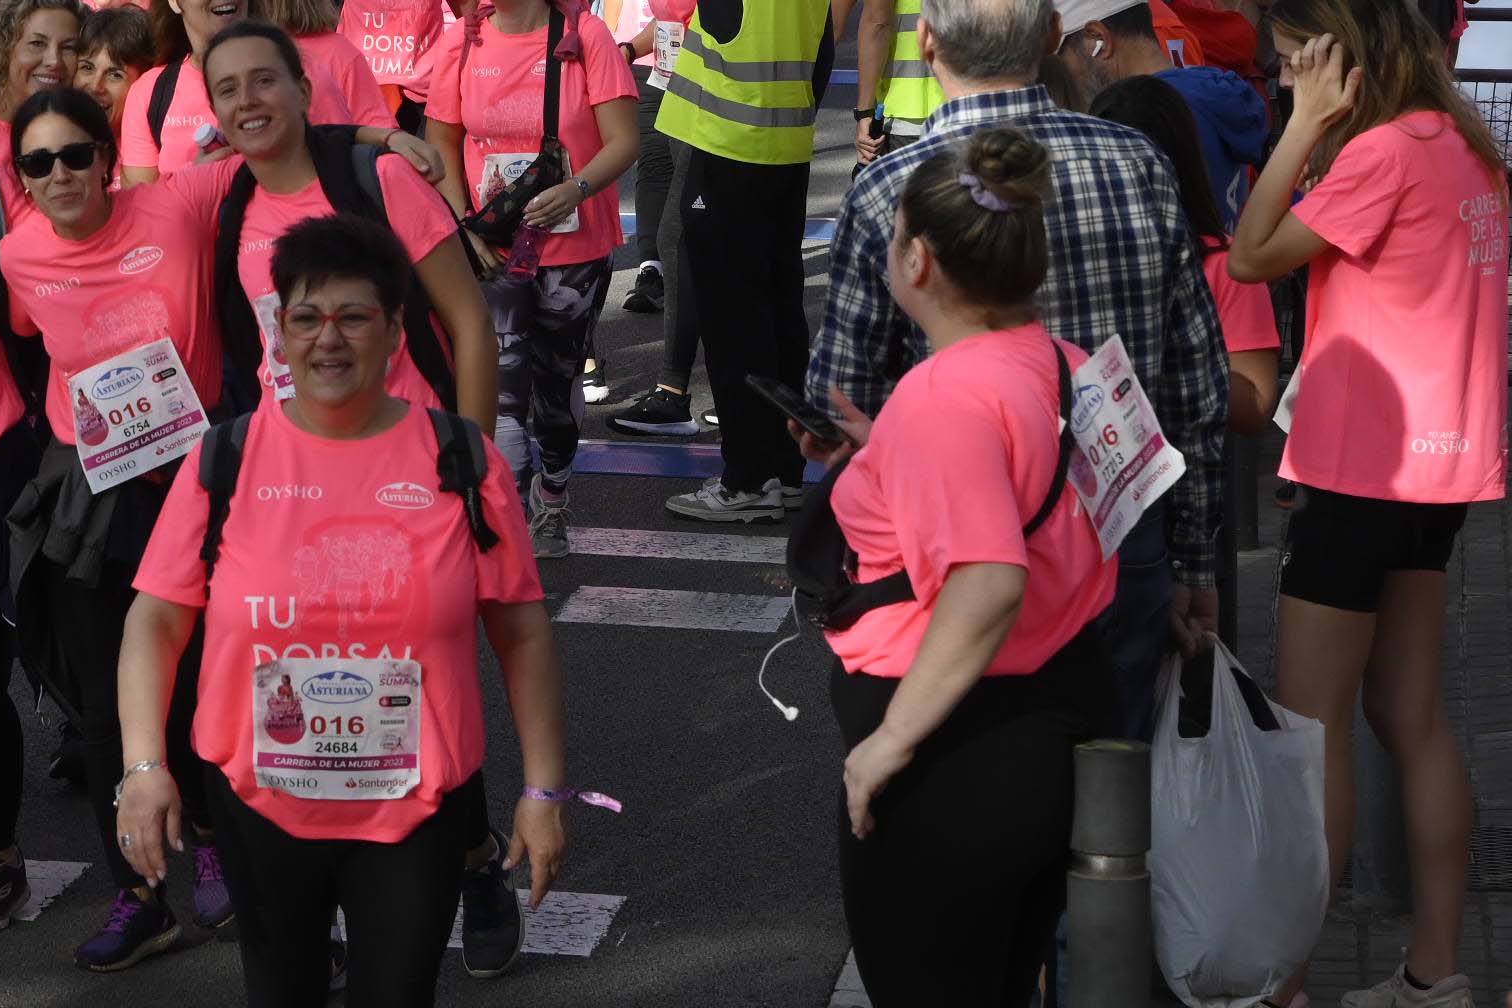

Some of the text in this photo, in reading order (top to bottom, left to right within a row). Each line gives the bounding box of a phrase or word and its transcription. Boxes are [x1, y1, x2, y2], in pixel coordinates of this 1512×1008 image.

[363, 12, 385, 29] TU
[365, 57, 415, 75] UMA
[1472, 218, 1487, 242] DE
[243, 239, 277, 255] OYSH
[122, 249, 163, 274] ASTURIANA
[35, 277, 81, 298] OYSHO
[146, 355, 170, 368] SUMA
[96, 372, 142, 396] ASTURIANA
[108, 397, 152, 425] 016
[124, 419, 151, 438] 6754
[96, 446, 129, 464] CARRERA
[129, 441, 140, 451] DE
[140, 435, 151, 446] LA
[150, 425, 176, 442] MUJER
[1088, 423, 1119, 467] 016
[1411, 438, 1470, 455] OYSHO
[99, 430, 203, 482] OYSHO Santander
[257, 485, 323, 500] OYSHO
[381, 493, 429, 505] ASTURIANA
[244, 595, 296, 629] TU
[307, 682, 368, 697] ASTURIANA
[379, 677, 410, 687] SUMA
[310, 716, 365, 735] 016
[315, 741, 358, 754] 24684
[274, 757, 404, 769] CARRERA DE LA MUJER 2023
[269, 775, 408, 789] OYSHO Santander
